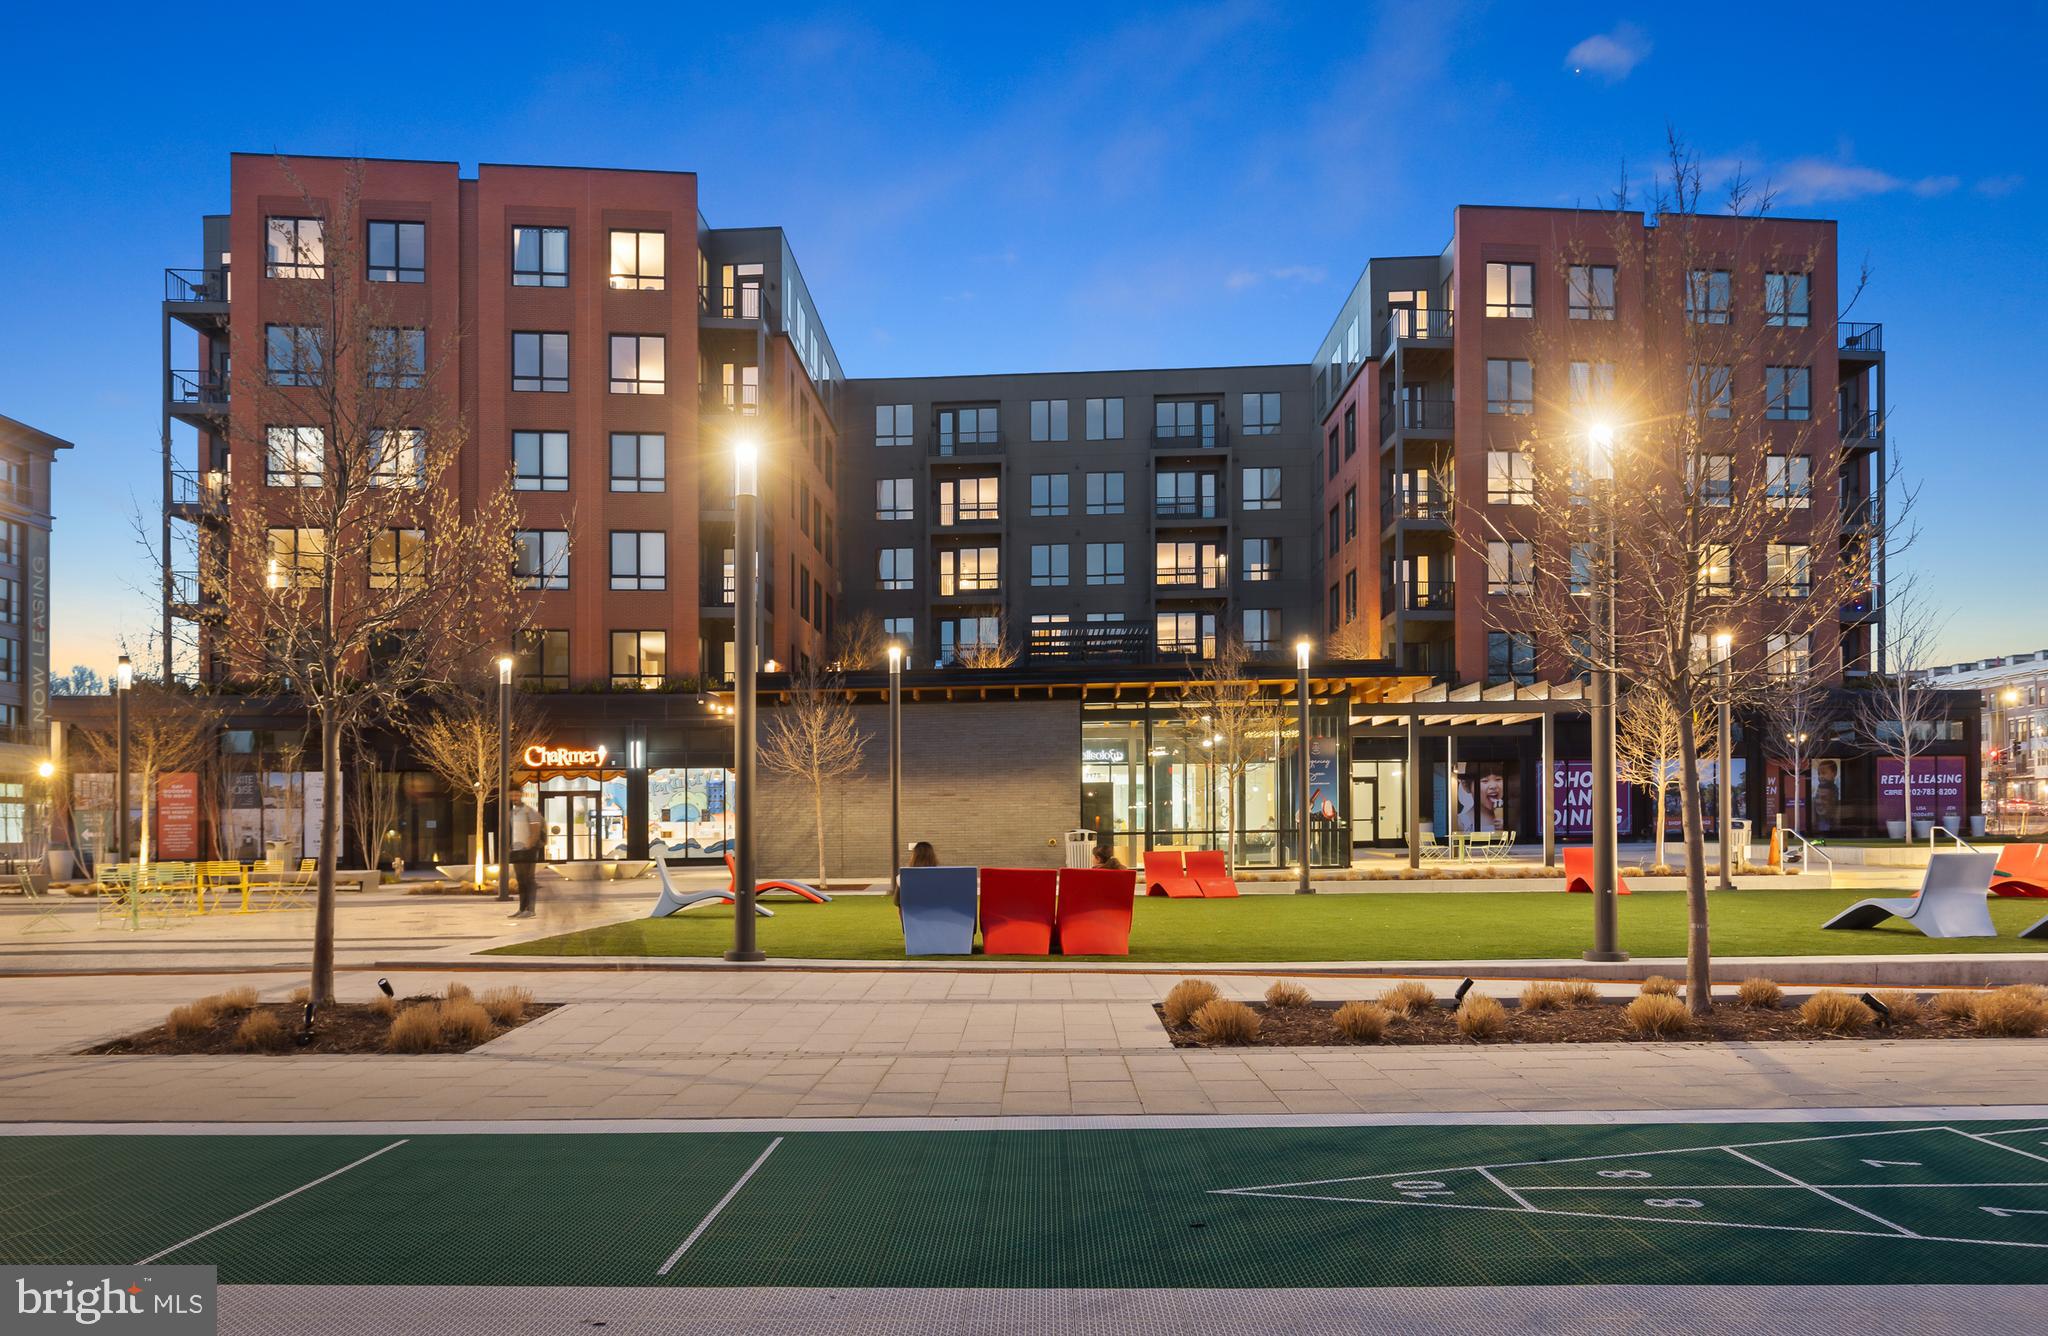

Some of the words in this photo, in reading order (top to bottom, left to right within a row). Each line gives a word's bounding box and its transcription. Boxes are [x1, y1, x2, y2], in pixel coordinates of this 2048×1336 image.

[32, 556, 46, 657] LEASING
[32, 666, 46, 723] NOW
[1554, 770, 1593, 788] SHO
[1880, 774, 1916, 785] RETAL
[1918, 773, 1962, 784] LEASING
[1562, 789, 1592, 806] AN
[1554, 807, 1623, 826] DINIG
[1596, 1169, 1653, 1179] 8
[1392, 1180, 1455, 1199] 10
[1646, 1197, 1705, 1208] 8
